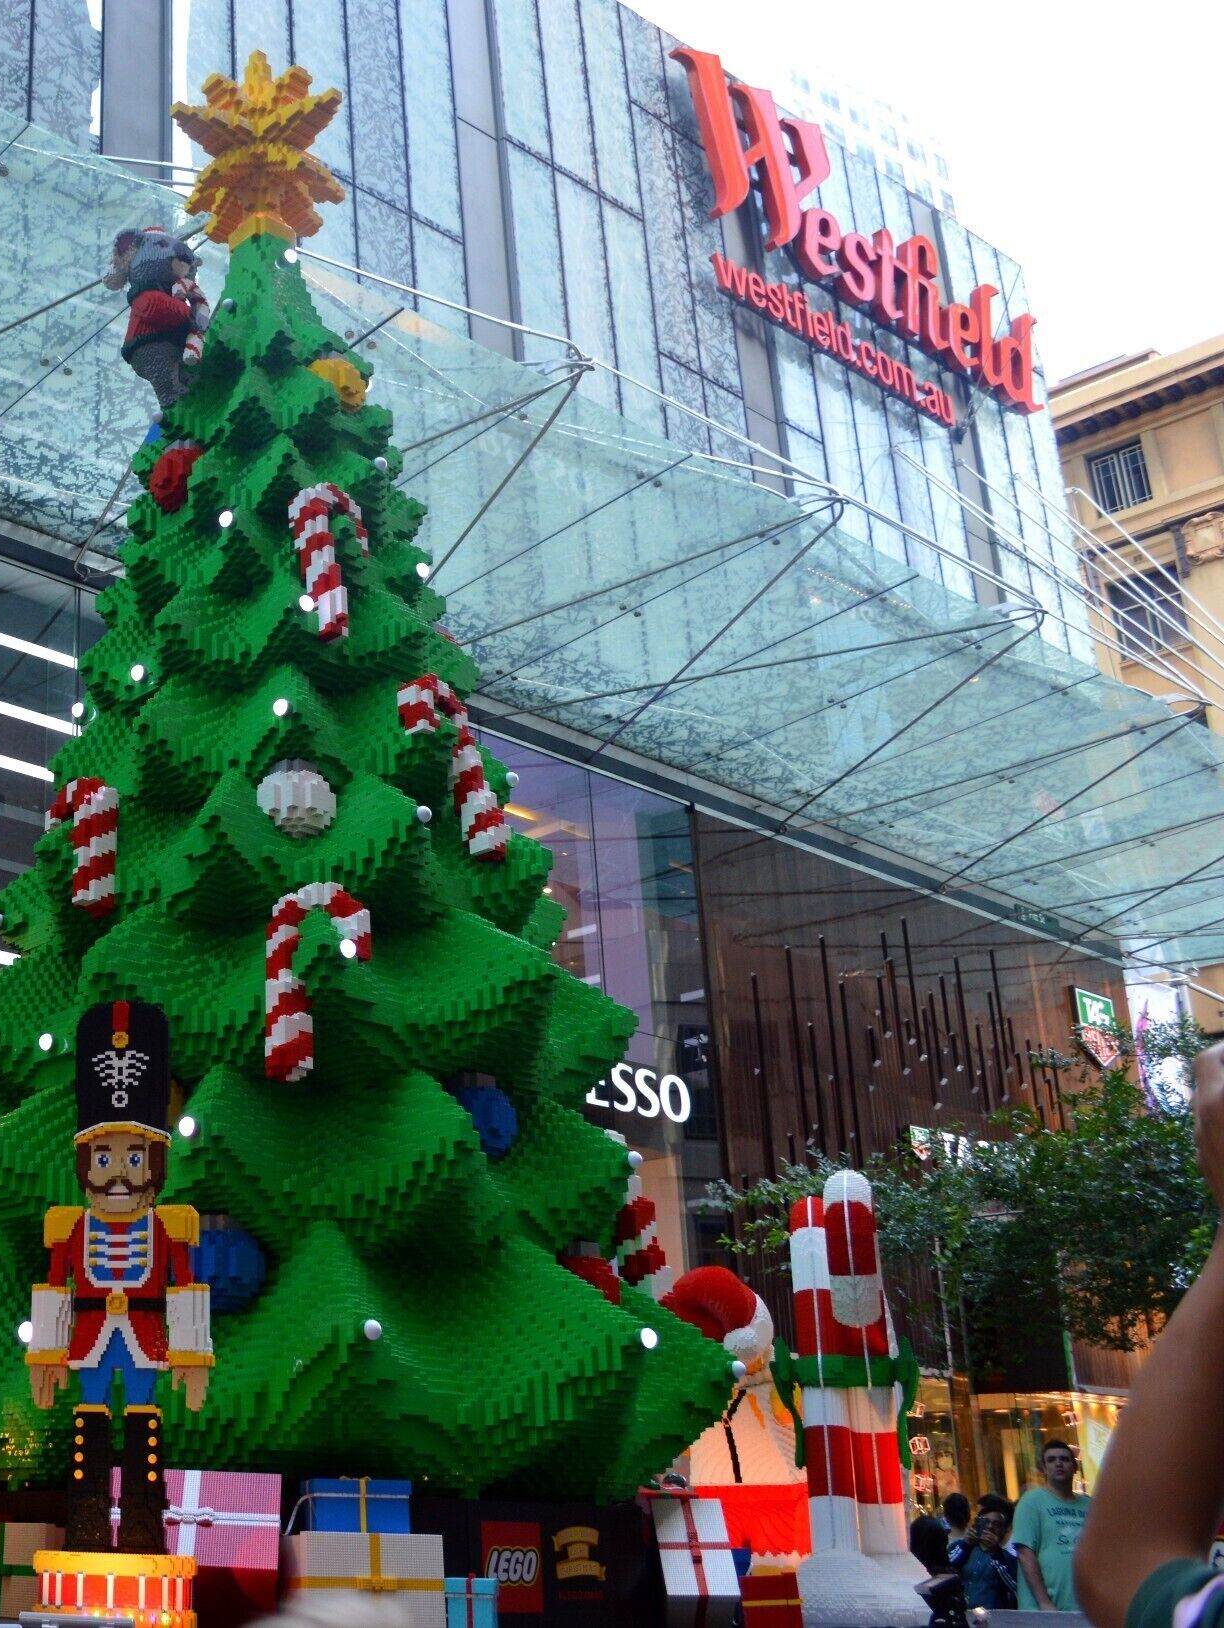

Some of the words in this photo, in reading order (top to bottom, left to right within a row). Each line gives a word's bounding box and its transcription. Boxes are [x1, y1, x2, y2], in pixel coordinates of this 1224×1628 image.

[669, 48, 1044, 416] Westfield
[710, 252, 956, 427] westfield.com.au
[487, 1549, 538, 1582] LEGO
